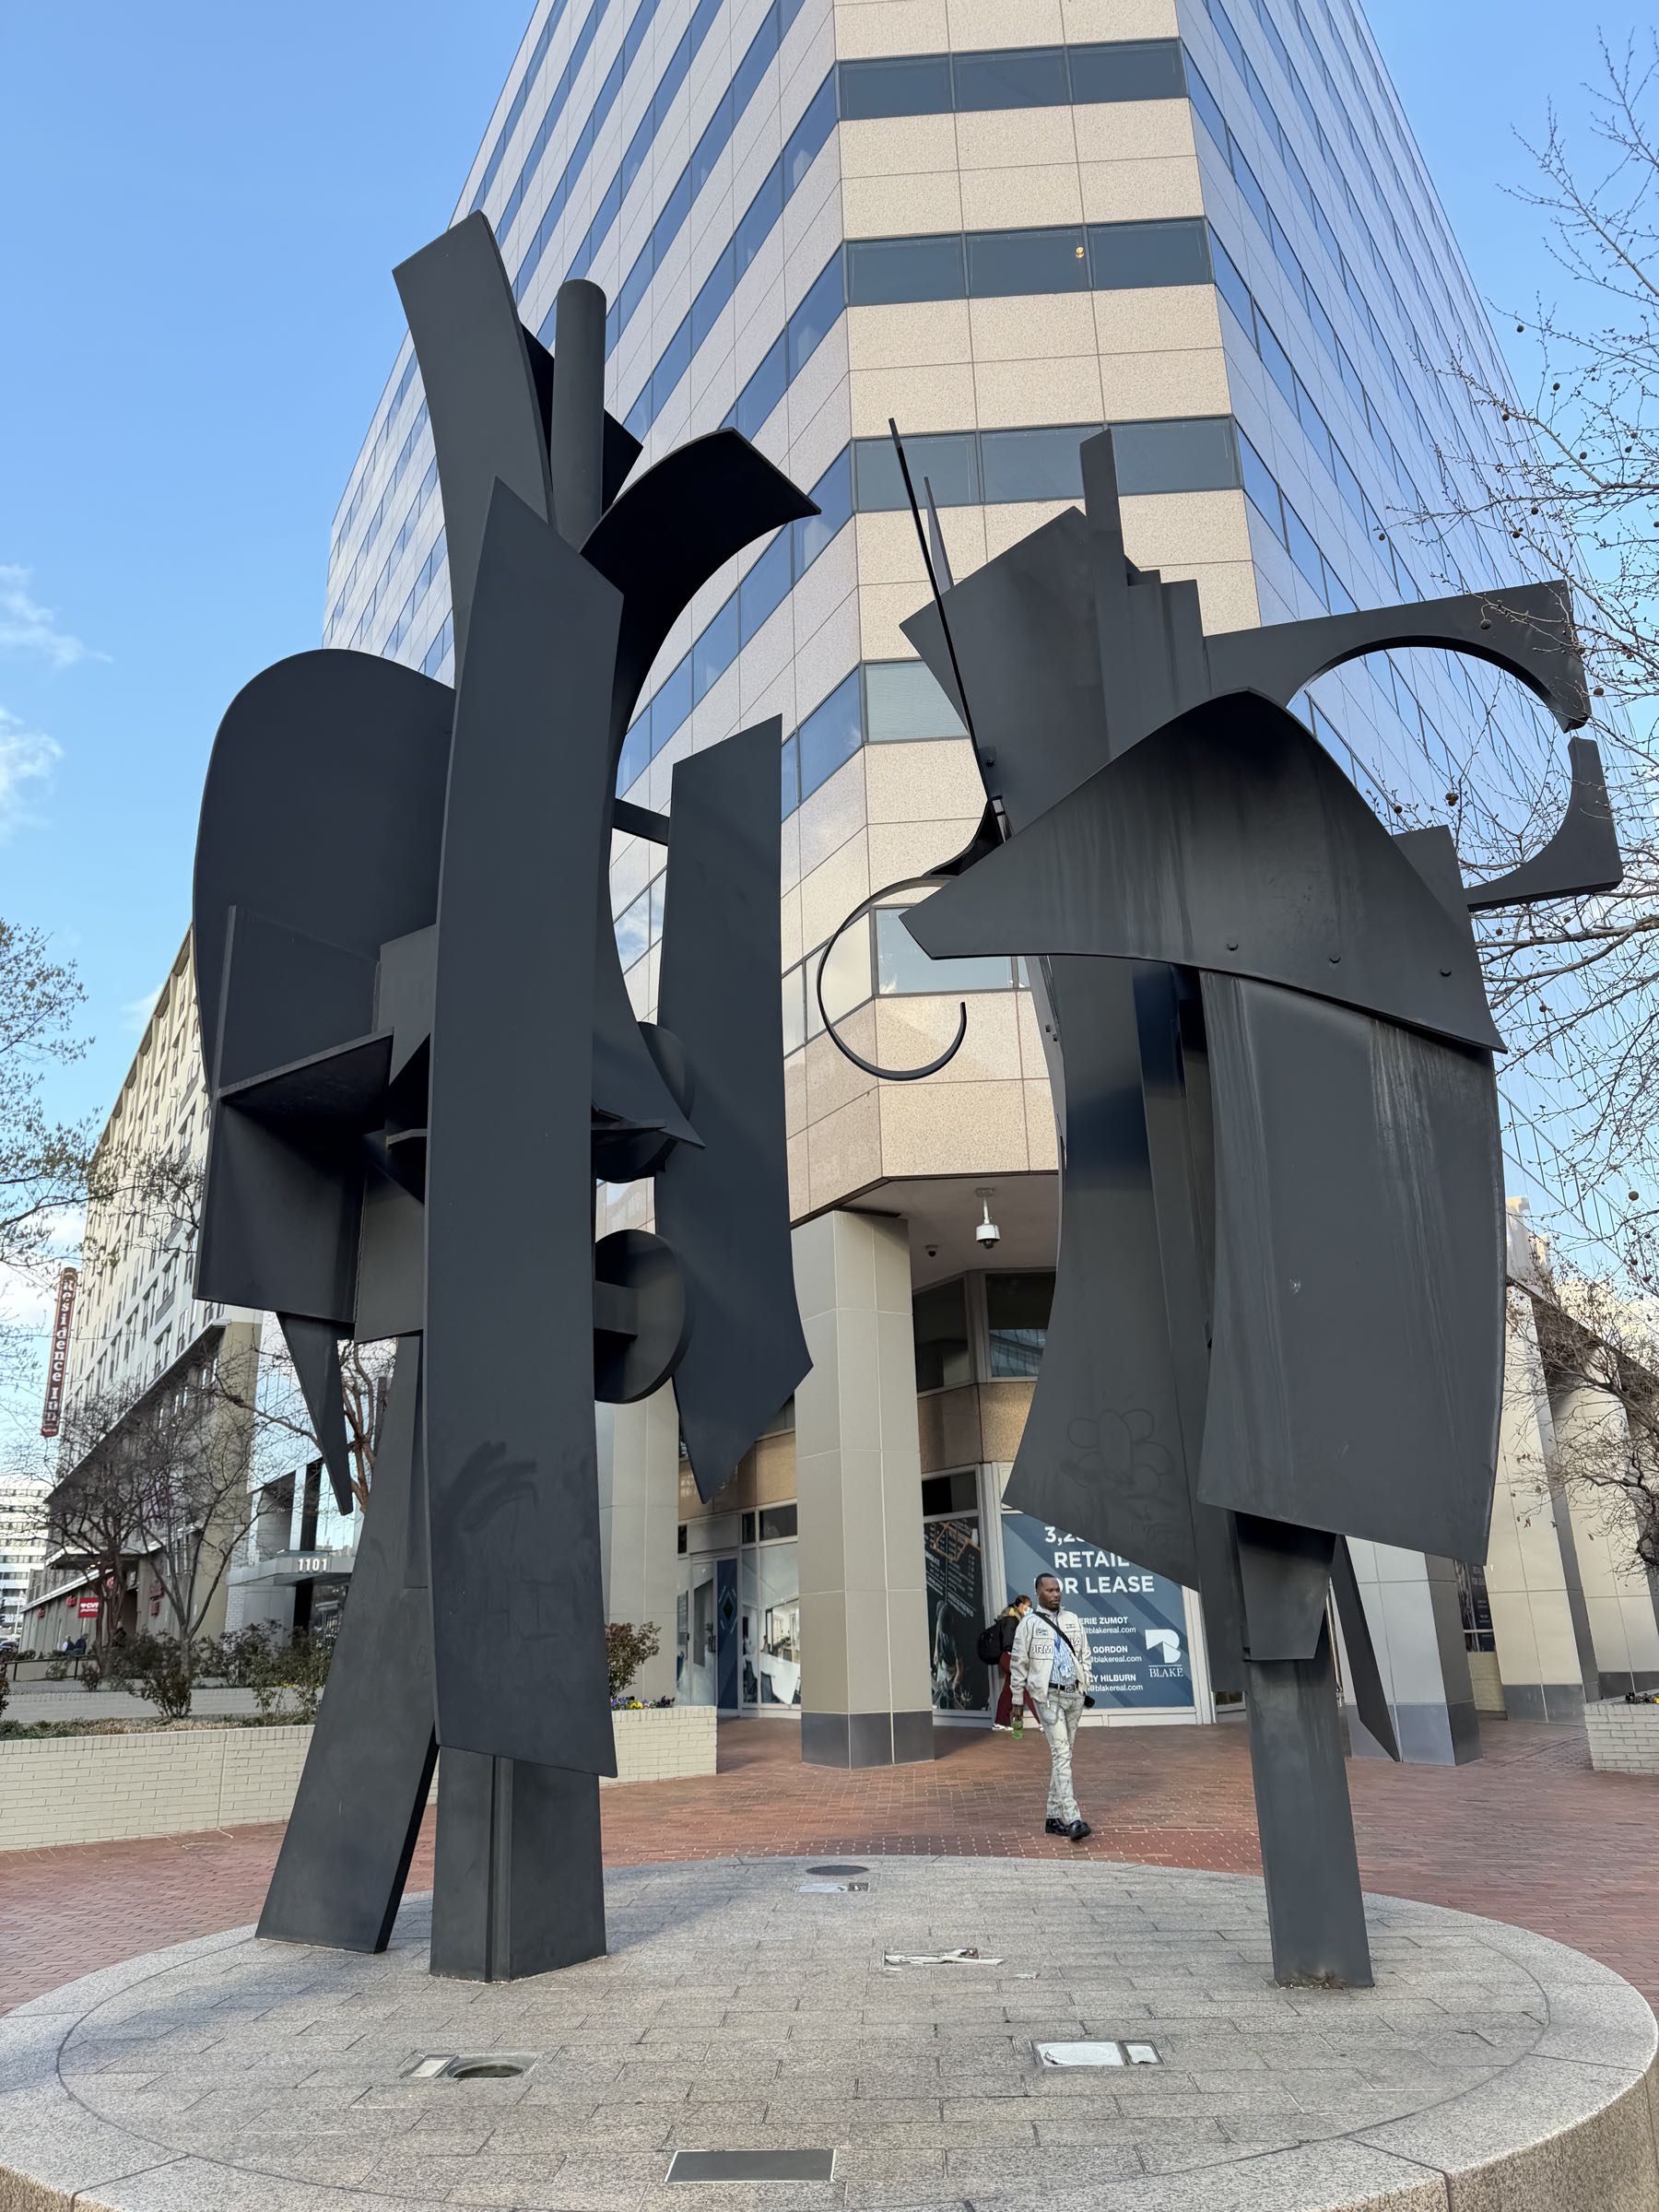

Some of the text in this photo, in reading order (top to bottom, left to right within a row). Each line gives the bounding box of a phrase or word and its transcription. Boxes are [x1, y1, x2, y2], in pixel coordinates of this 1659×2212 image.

[298, 1558, 327, 1572] 1101
[1053, 1550, 1130, 1569] RETAIL
[1085, 1575, 1155, 1594] LEASE
[1099, 1616, 1129, 1625] ZUMOT
[1092, 1645, 1128, 1653] GORDON
[1100, 1674, 1136, 1682] HILBURN
[1148, 1667, 1184, 1678] BLAKE
